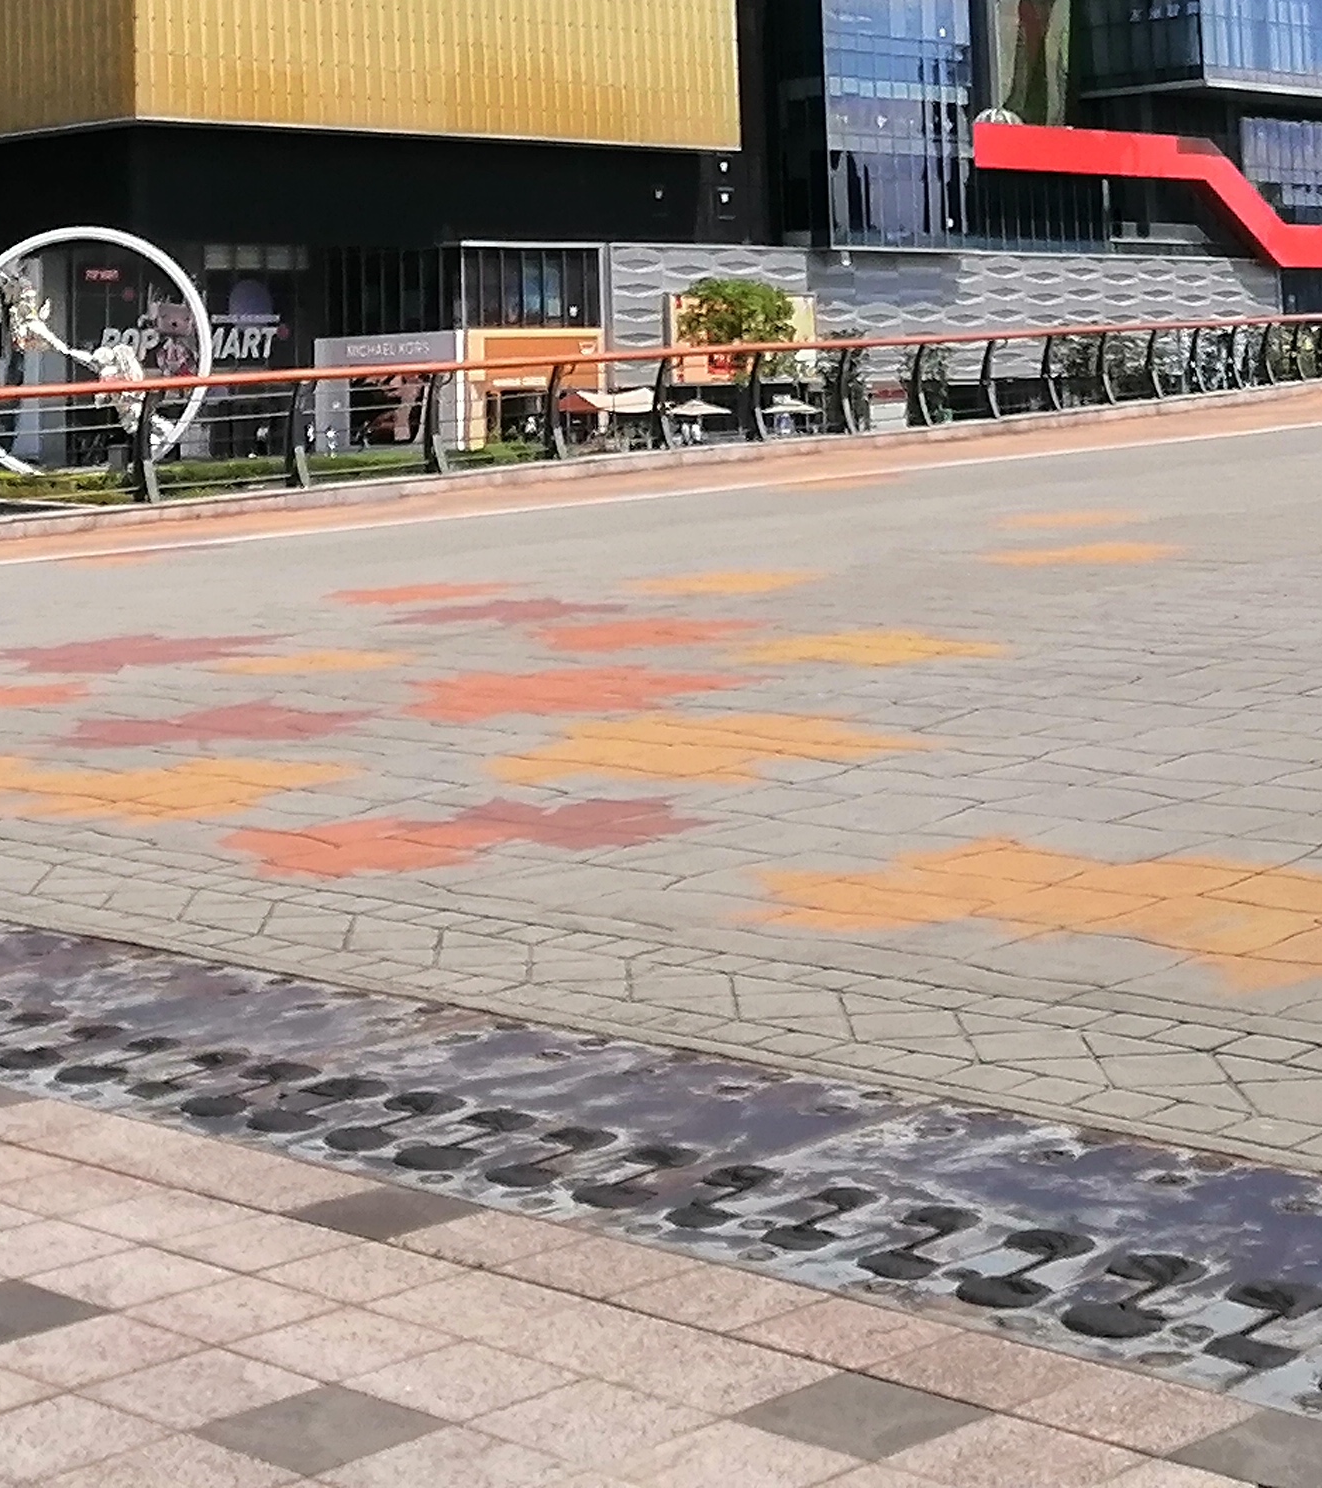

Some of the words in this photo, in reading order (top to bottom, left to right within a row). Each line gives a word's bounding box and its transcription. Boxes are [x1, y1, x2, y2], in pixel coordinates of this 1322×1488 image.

[102, 327, 160, 360] POP
[346, 343, 395, 358] MICHAEL
[398, 341, 430, 355] KORS
